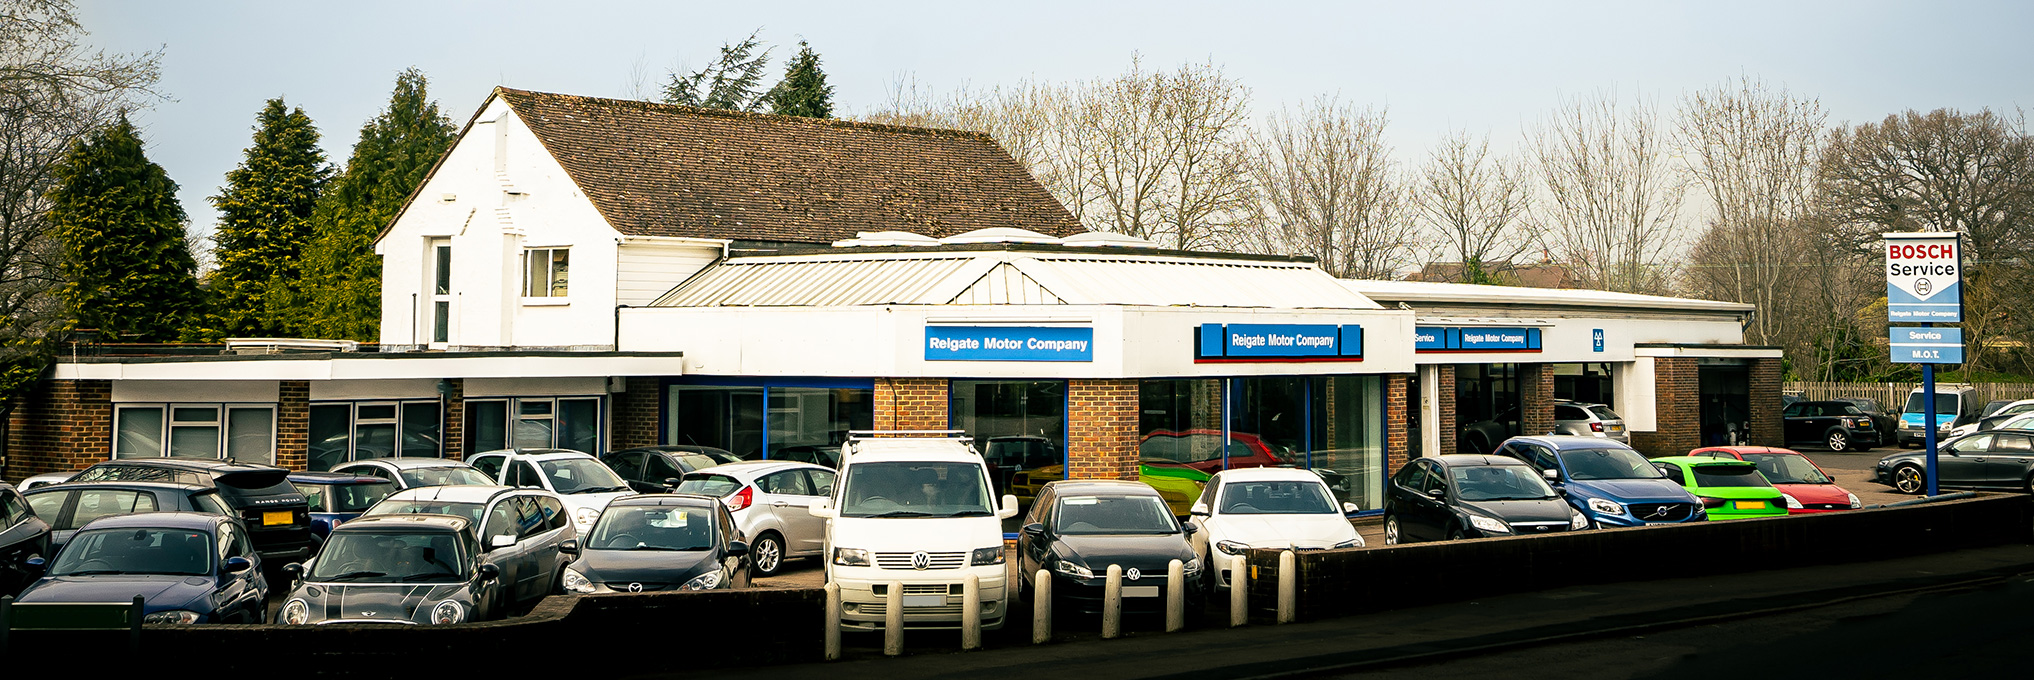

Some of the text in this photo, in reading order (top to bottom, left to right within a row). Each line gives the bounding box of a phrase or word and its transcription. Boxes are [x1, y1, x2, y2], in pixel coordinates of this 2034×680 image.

[1889, 244, 1953, 259] BOSCH
[1890, 262, 1954, 276] Service
[1890, 310, 1912, 318] Reigate
[1931, 310, 1957, 318] Company
[1232, 334, 1334, 348] Reigate Motor Company
[1415, 333, 1435, 343] Service
[1464, 333, 1524, 344] Reigate Motor Company
[1909, 331, 1942, 340] Service
[929, 337, 1088, 352] Reigate Motor Company
[1912, 350, 1940, 359] M.O.T.
